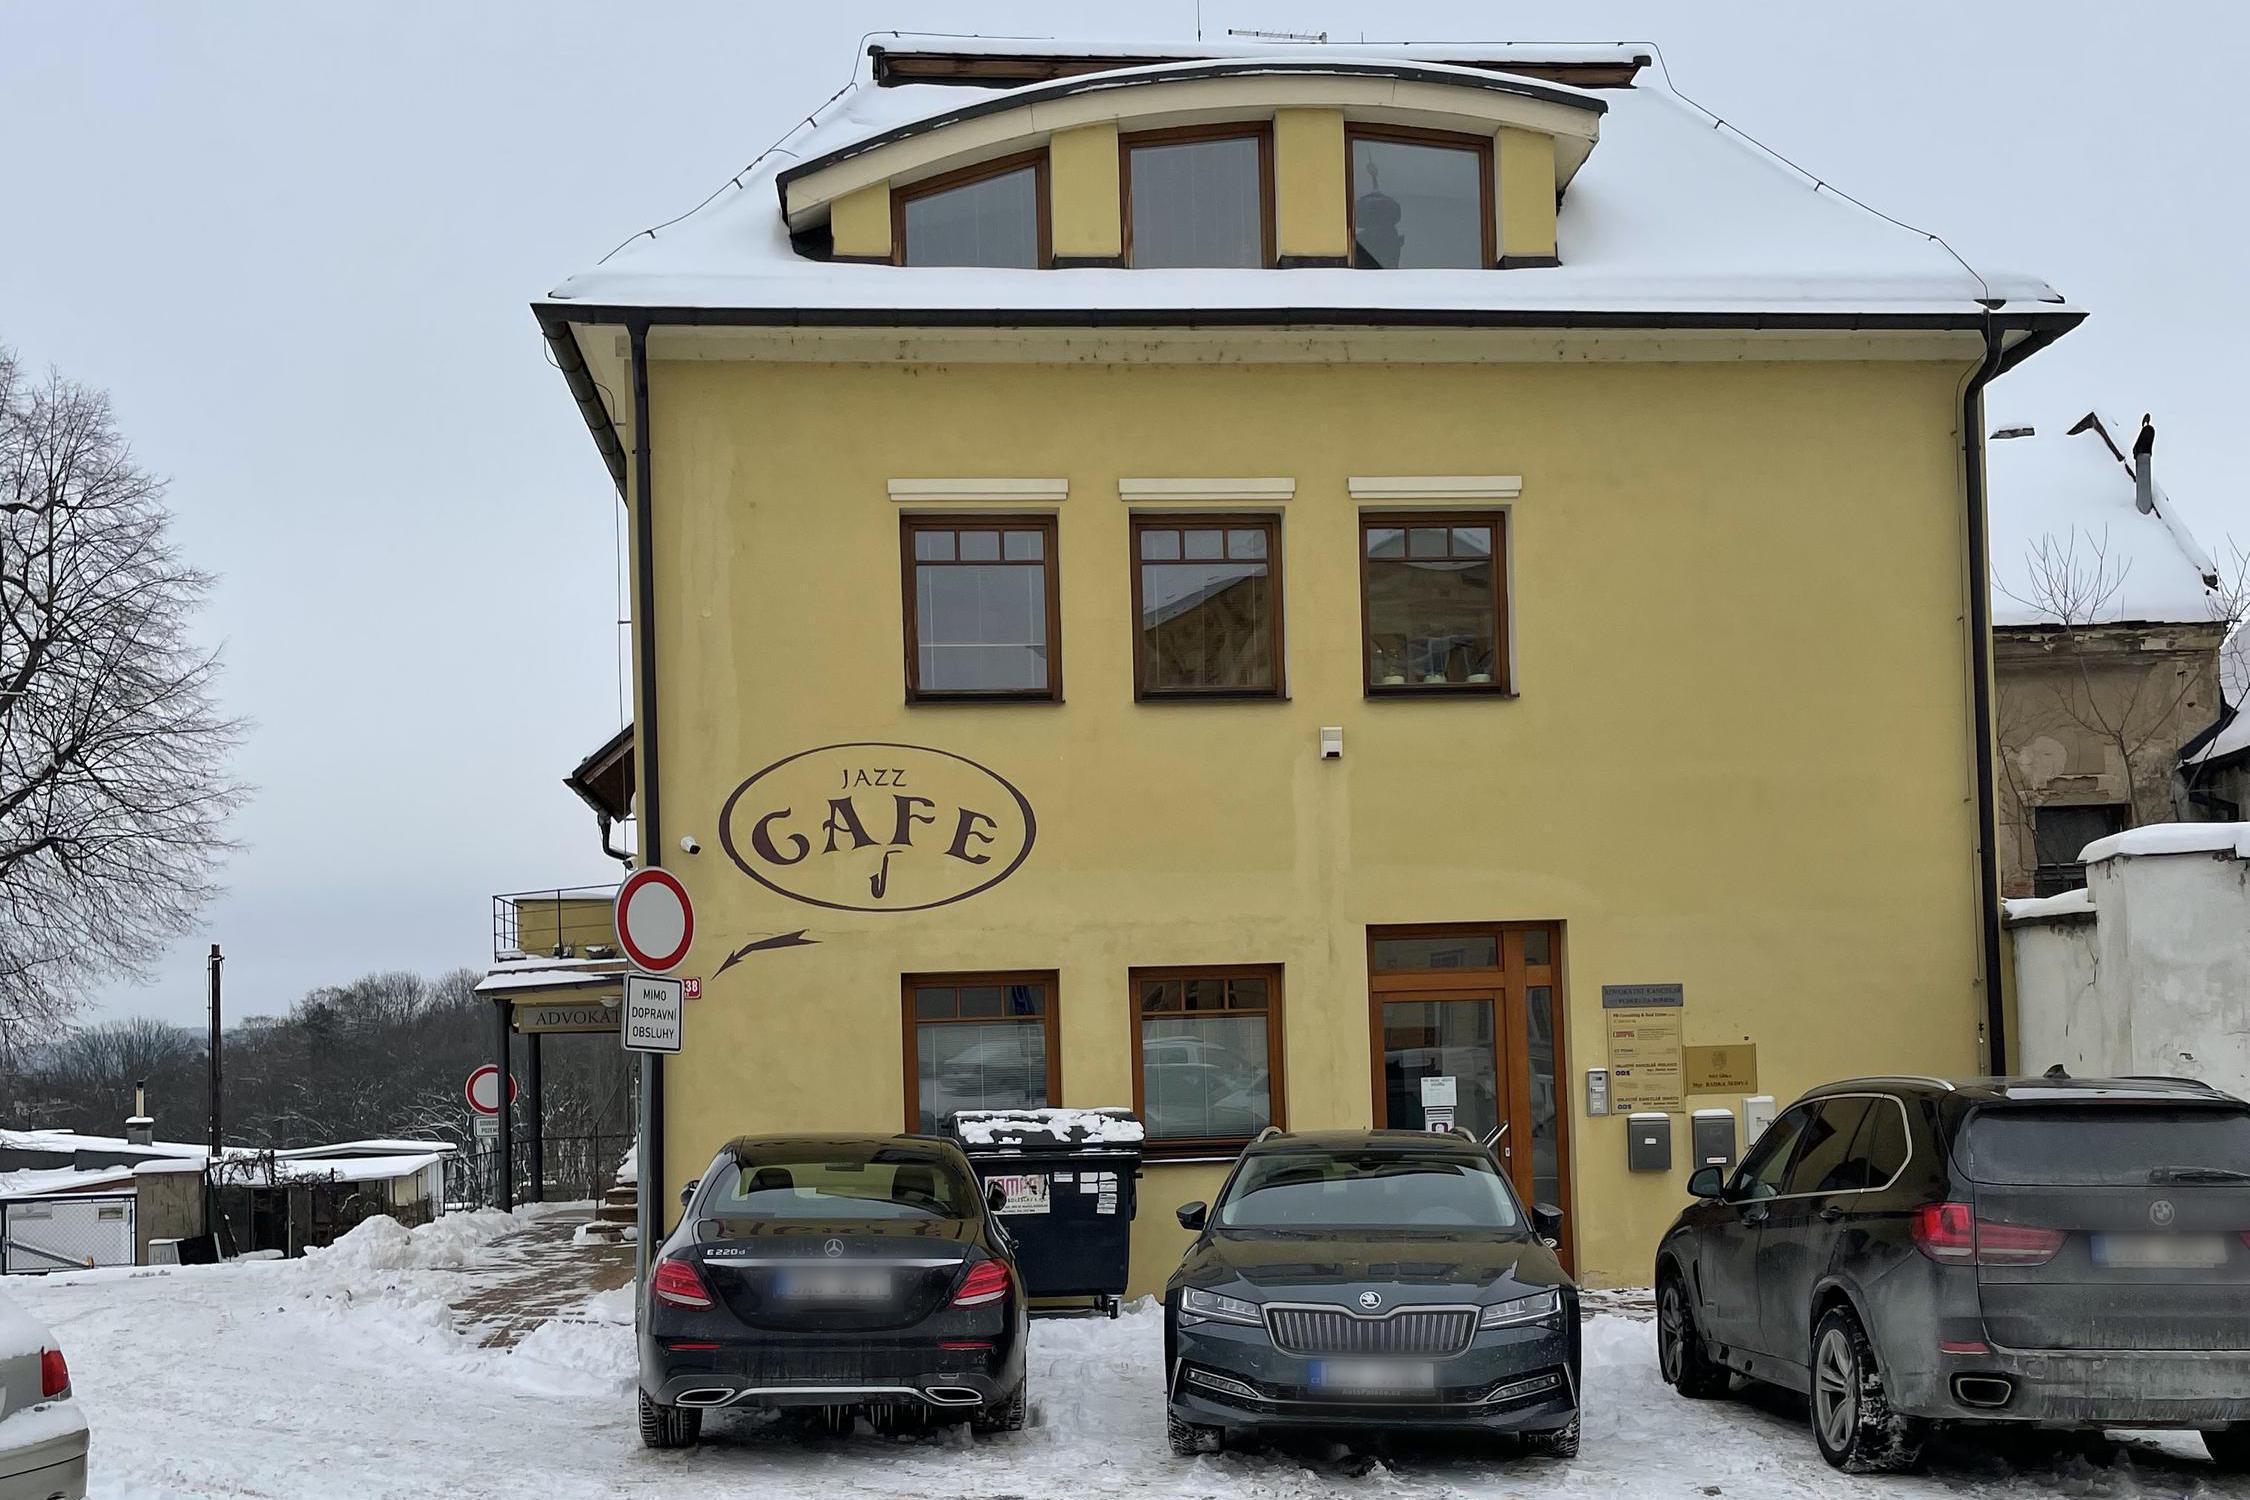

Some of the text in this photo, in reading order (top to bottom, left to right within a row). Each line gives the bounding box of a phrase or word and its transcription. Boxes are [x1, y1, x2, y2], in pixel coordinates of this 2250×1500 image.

[841, 768, 908, 789] JAZZ
[751, 794, 998, 865] CAFE
[643, 987, 667, 1001] MIMO
[631, 1006, 677, 1021] DOPRAVNÍ
[632, 1025, 675, 1039] OBSLUHY
